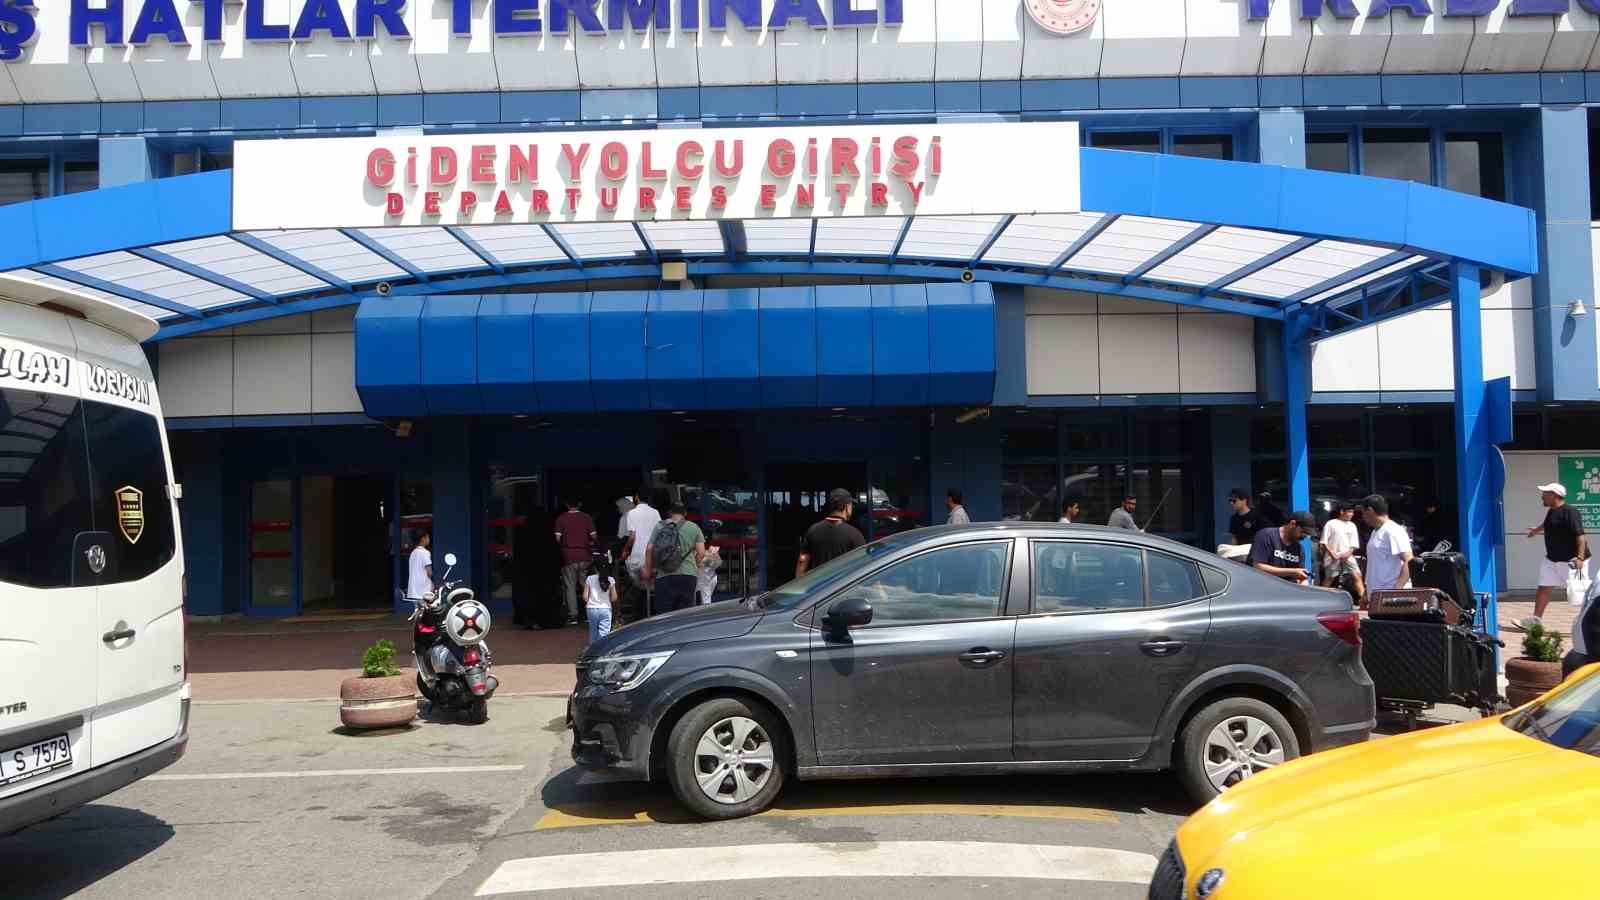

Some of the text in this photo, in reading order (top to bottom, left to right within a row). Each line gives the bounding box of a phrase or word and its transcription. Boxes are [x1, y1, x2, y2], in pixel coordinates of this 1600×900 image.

[561, 138, 745, 183] YOLCU
[386, 181, 925, 217] DEPARTURES ENTRY
[32, 739, 68, 768] 7579
